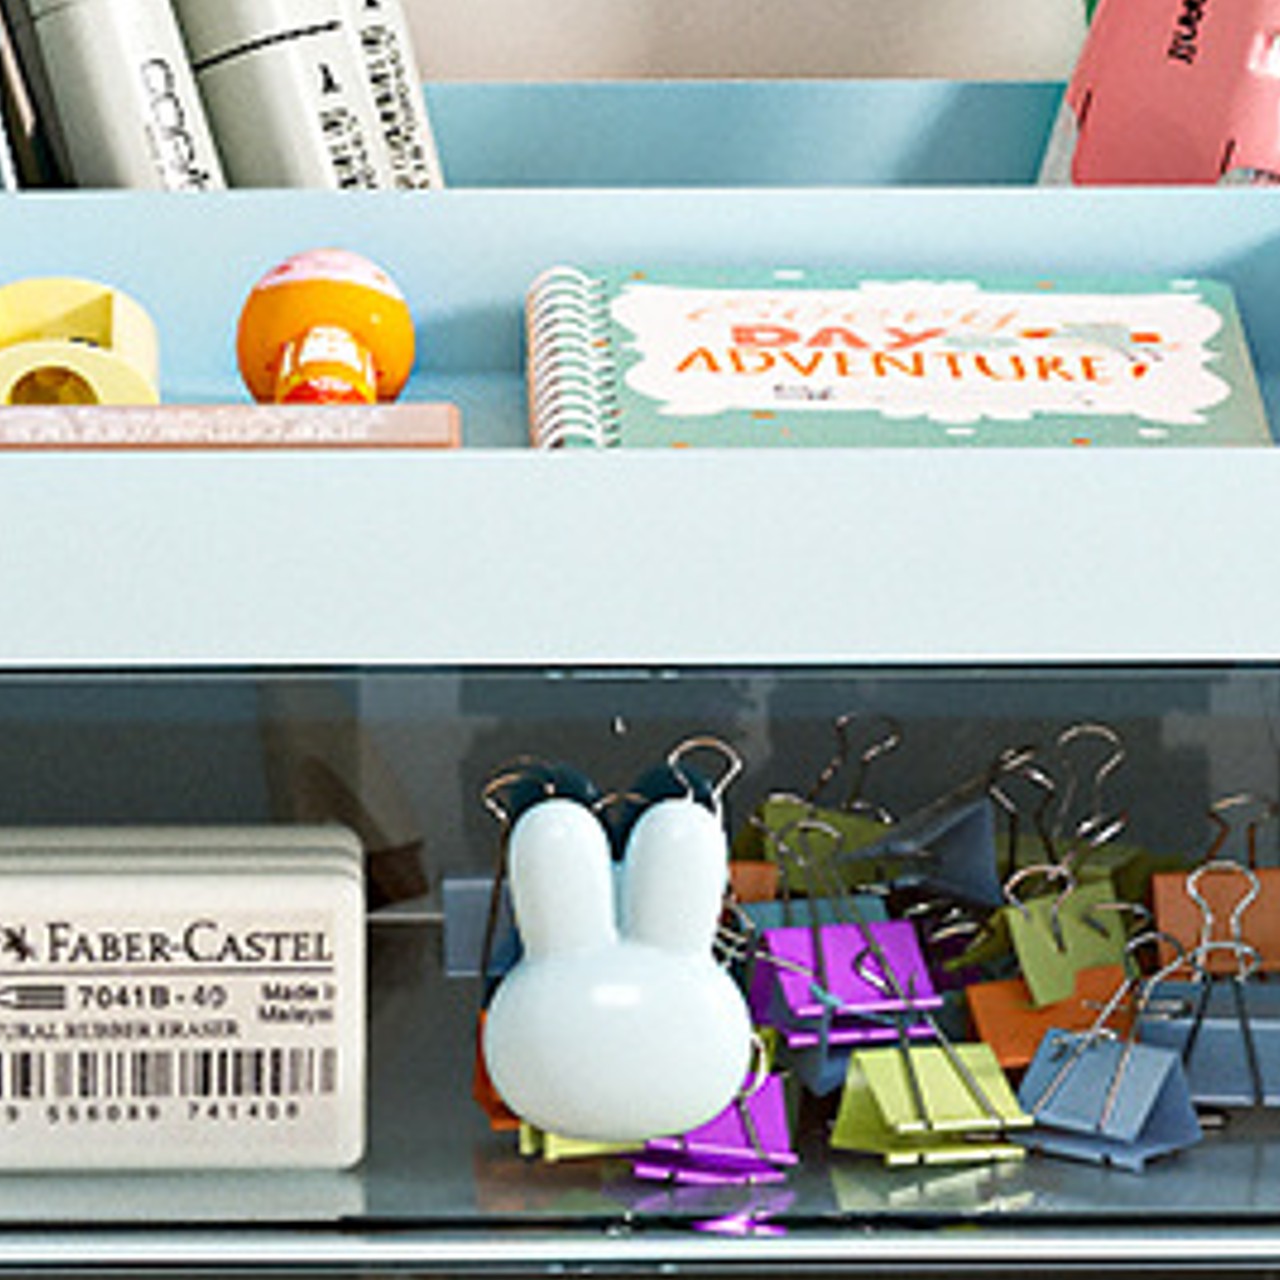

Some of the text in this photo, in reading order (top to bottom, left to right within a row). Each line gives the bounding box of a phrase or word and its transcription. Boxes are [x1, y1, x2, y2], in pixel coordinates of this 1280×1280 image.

[730, 324, 948, 349] DAY
[261, 980, 319, 1001] Made
[65, 1020, 152, 1040] RUBBER
[158, 1019, 239, 1038] ERASER
